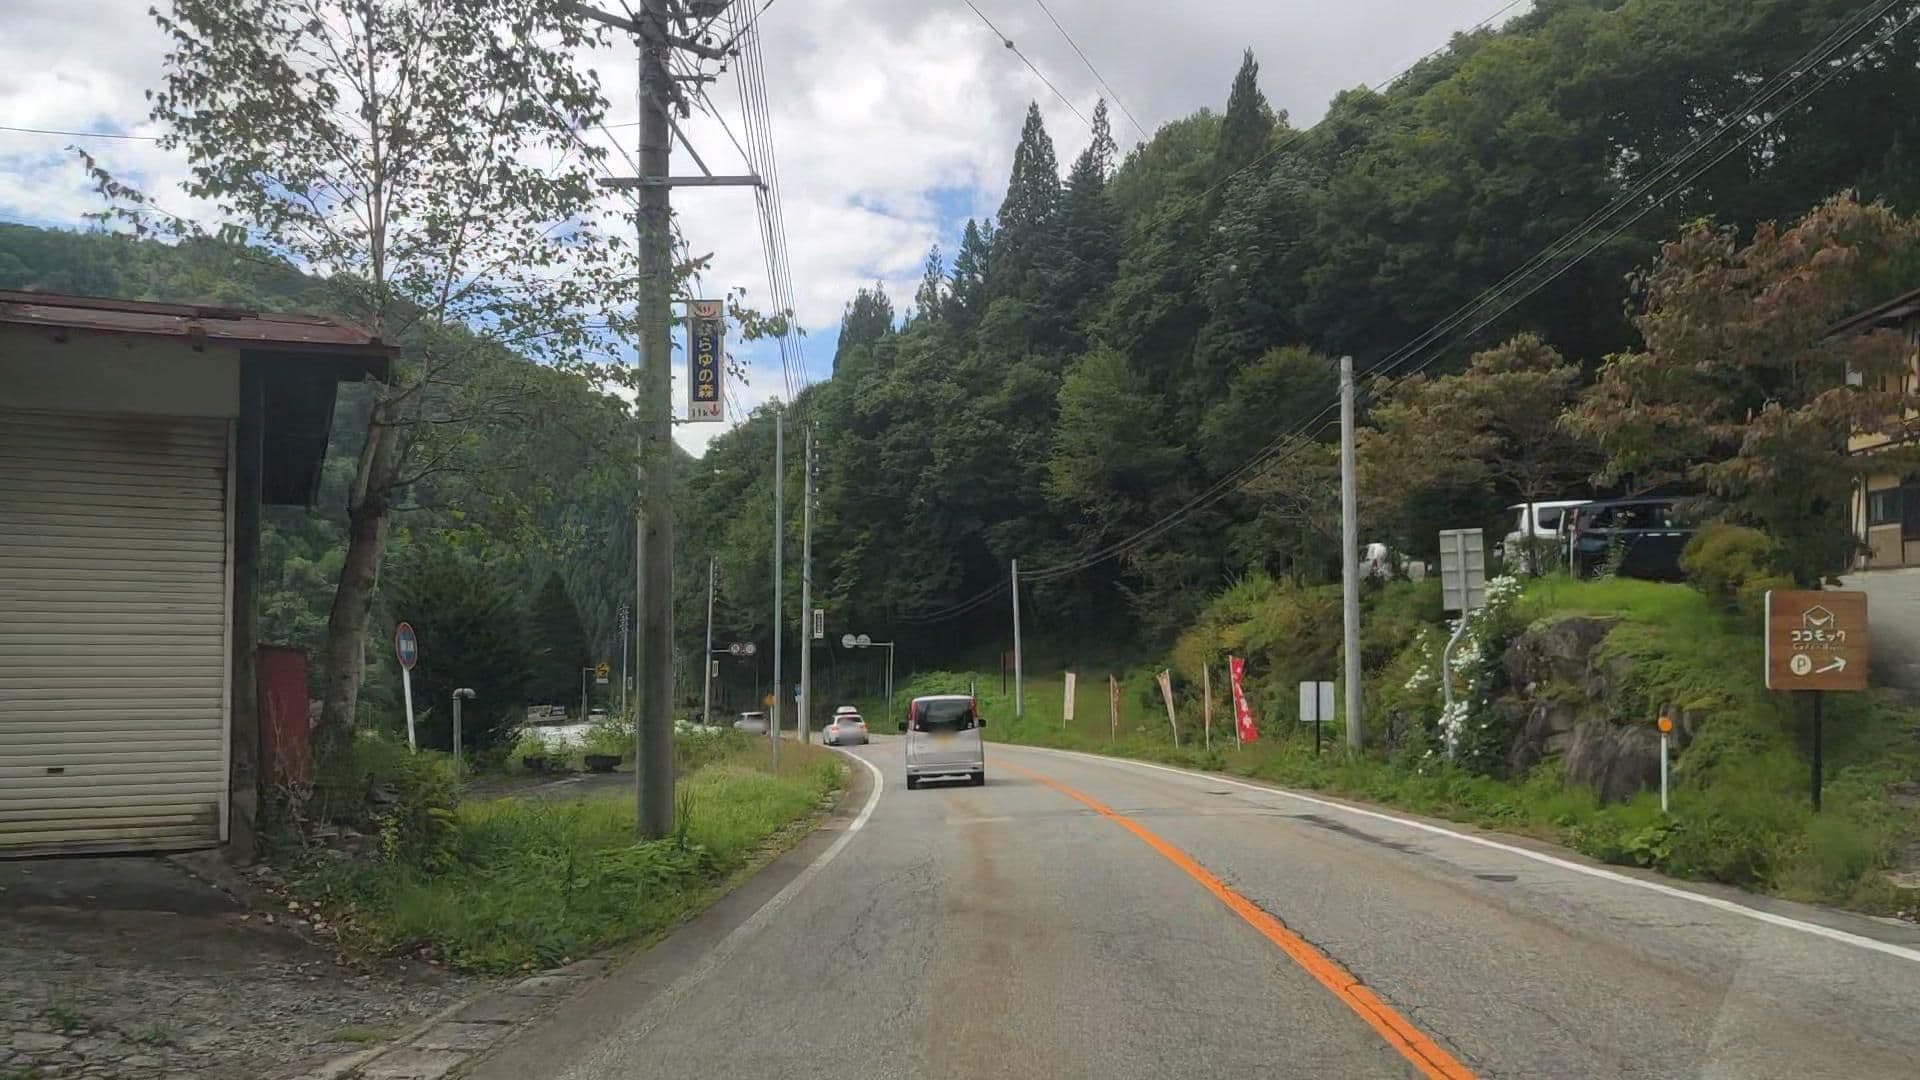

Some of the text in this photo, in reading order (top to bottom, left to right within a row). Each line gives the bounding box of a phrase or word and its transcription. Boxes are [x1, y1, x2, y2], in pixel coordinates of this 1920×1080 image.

[1791, 629, 1845, 642] ココモック
